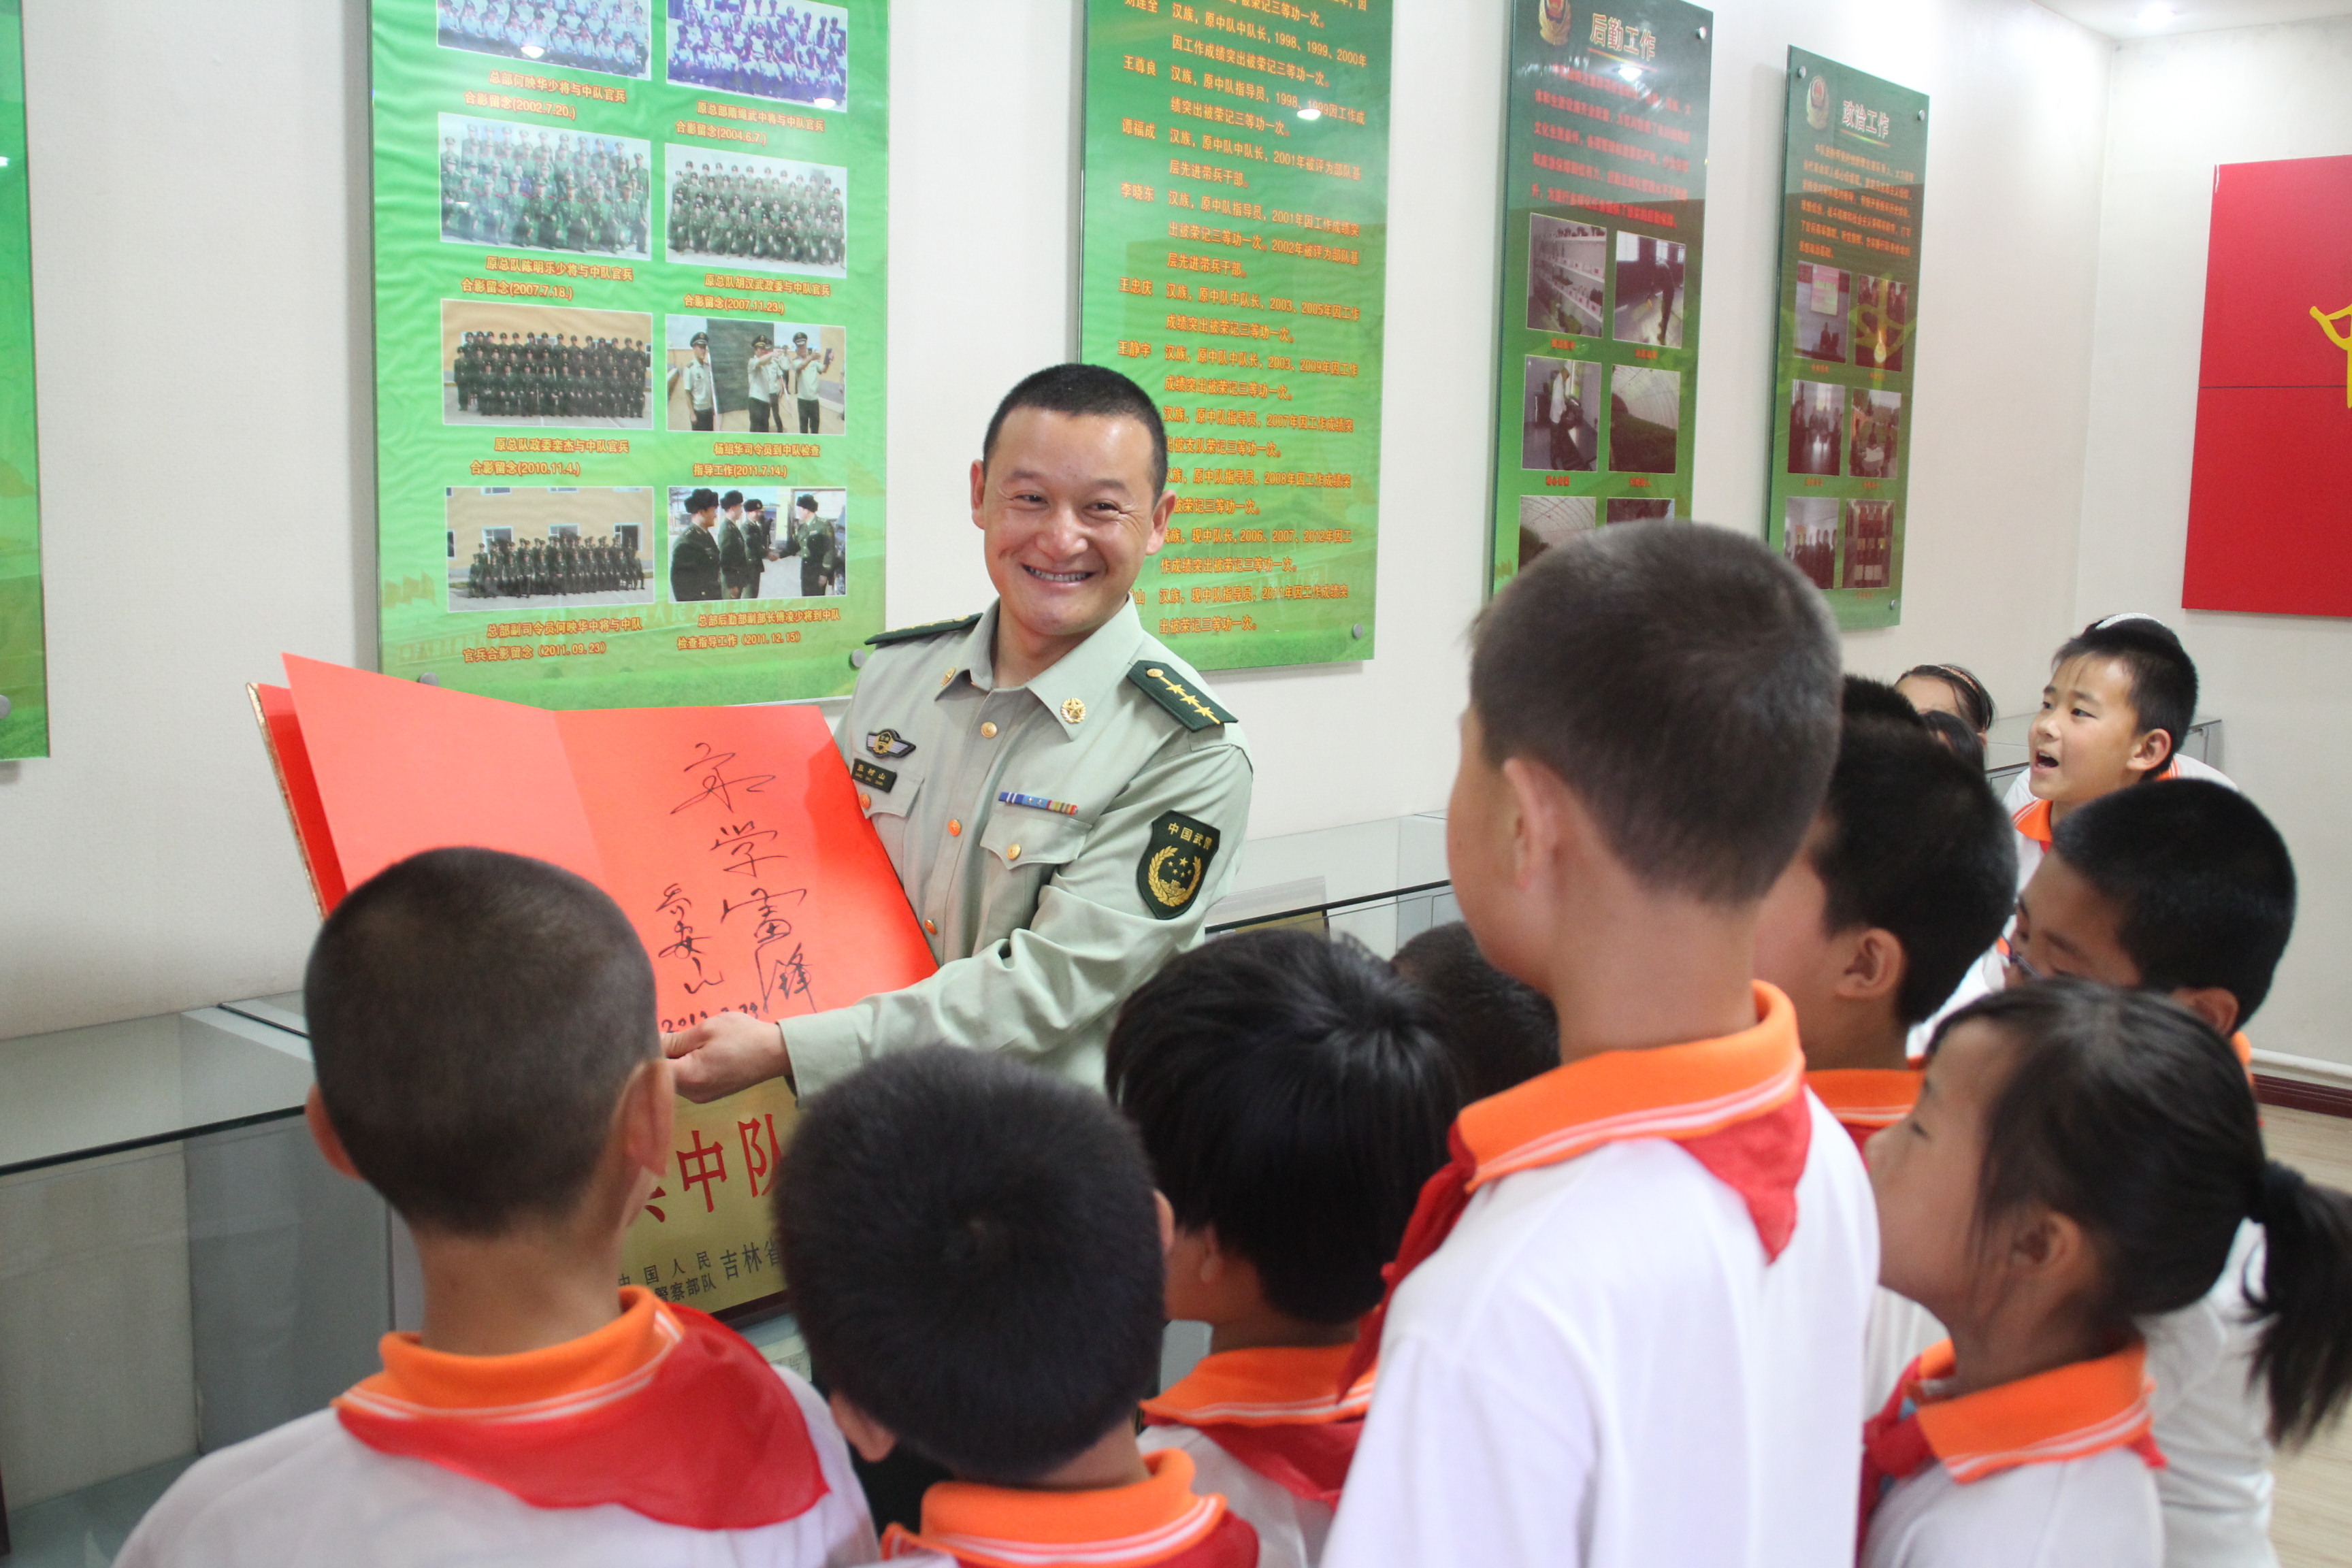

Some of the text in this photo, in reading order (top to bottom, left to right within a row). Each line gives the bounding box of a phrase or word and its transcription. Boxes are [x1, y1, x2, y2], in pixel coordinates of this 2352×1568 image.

[1173, 3, 1367, 67] 汉族，原中队中队长，1998、1999、2000年
[1590, 12, 1656, 61] 后勤工作
[1124, 55, 1157, 77] 王尊良
[1173, 34, 1330, 88] 因工作成绩突出被荣记三等功一次。
[489, 70, 627, 104] 总部何映华少将与中队官兵
[464, 91, 576, 120] 合影留念(2002.7.20.)
[1171, 97, 1290, 137] 绩突出被荣记三等功一次。
[1842, 99, 1889, 139] 政治工作
[676, 120, 767, 146] 合影留念(2004.6.7.)
[1123, 118, 1362, 182] 谭福成 汉族，原中队中队长，2001年被评为部队基
[1171, 159, 1249, 189] 层先进带兵干部。
[1122, 182, 1360, 238] 李晓东 汉族，原中队指导员，2001年因工作成绩突
[1169, 222, 1360, 266] 出被荣记三等功一次。2002年被评为部队基
[487, 257, 634, 282] 原总队陈明乐少将与中队官兵
[1168, 252, 1247, 278] 层先进带兵干部。
[461, 278, 574, 301] 合影留念(2007.7.18.)
[706, 274, 832, 297] 原总队胡汉武政委与中队官兵
[685, 294, 785, 316] 合影留念(2007.11.23.)
[1120, 278, 1361, 322] 王忠庆 汉族，原中队中队长，2003、2005年因工作
[1166, 314, 1295, 343] 成绩突出被荣记三等功一次。
[1119, 341, 1359, 378] 王静宇 汉族，原中队中队长，2003、2009年因工作
[1165, 376, 1293, 401] 成绩突出被荣记三等功一次。
[1164, 406, 1354, 433] 汉族，原中队指导员，2007年因工作成绩突
[495, 438, 630, 454] 原总队政委栾杰与中队官兵
[714, 443, 821, 458] 杨绍华司令员到中队检查
[471, 461, 581, 477] 合影留念(2010.11.4.)
[693, 463, 788, 478] 指导工作(2011.7.14.)
[1161, 557, 1298, 574] 作成绩突出被荣记三等功一次。
[1160, 585, 1350, 605] 汉族，现中队指导员，2011年因工作成绩突
[487, 617, 644, 640] 总部副司令员何映华中将与中队
[1160, 616, 1258, 635] 出被荣记三等功一次。
[1168, 822, 1212, 849] 中国武警
